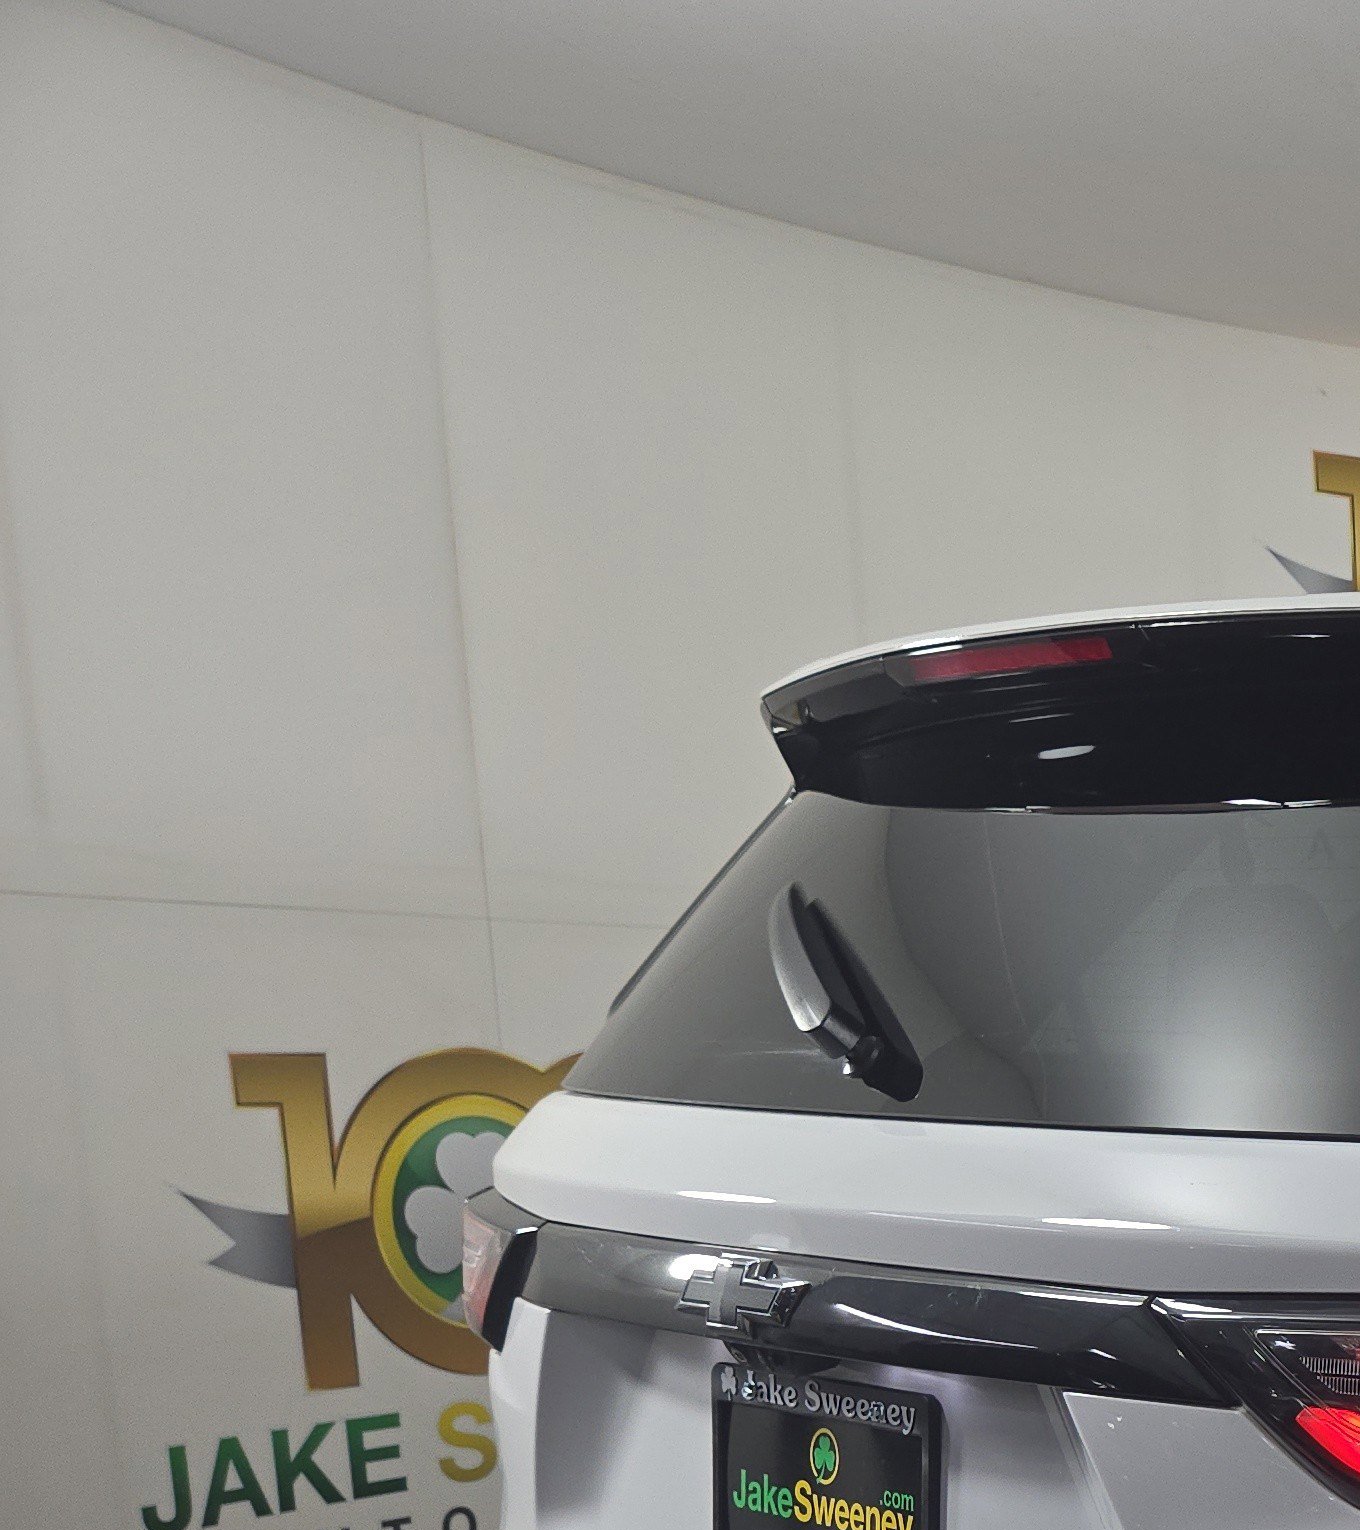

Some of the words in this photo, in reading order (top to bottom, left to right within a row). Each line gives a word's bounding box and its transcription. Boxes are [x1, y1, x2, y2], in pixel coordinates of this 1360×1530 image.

[228, 1047, 587, 1391] 10
[741, 1369, 797, 1408] Jake
[804, 1380, 915, 1436] Sweeney
